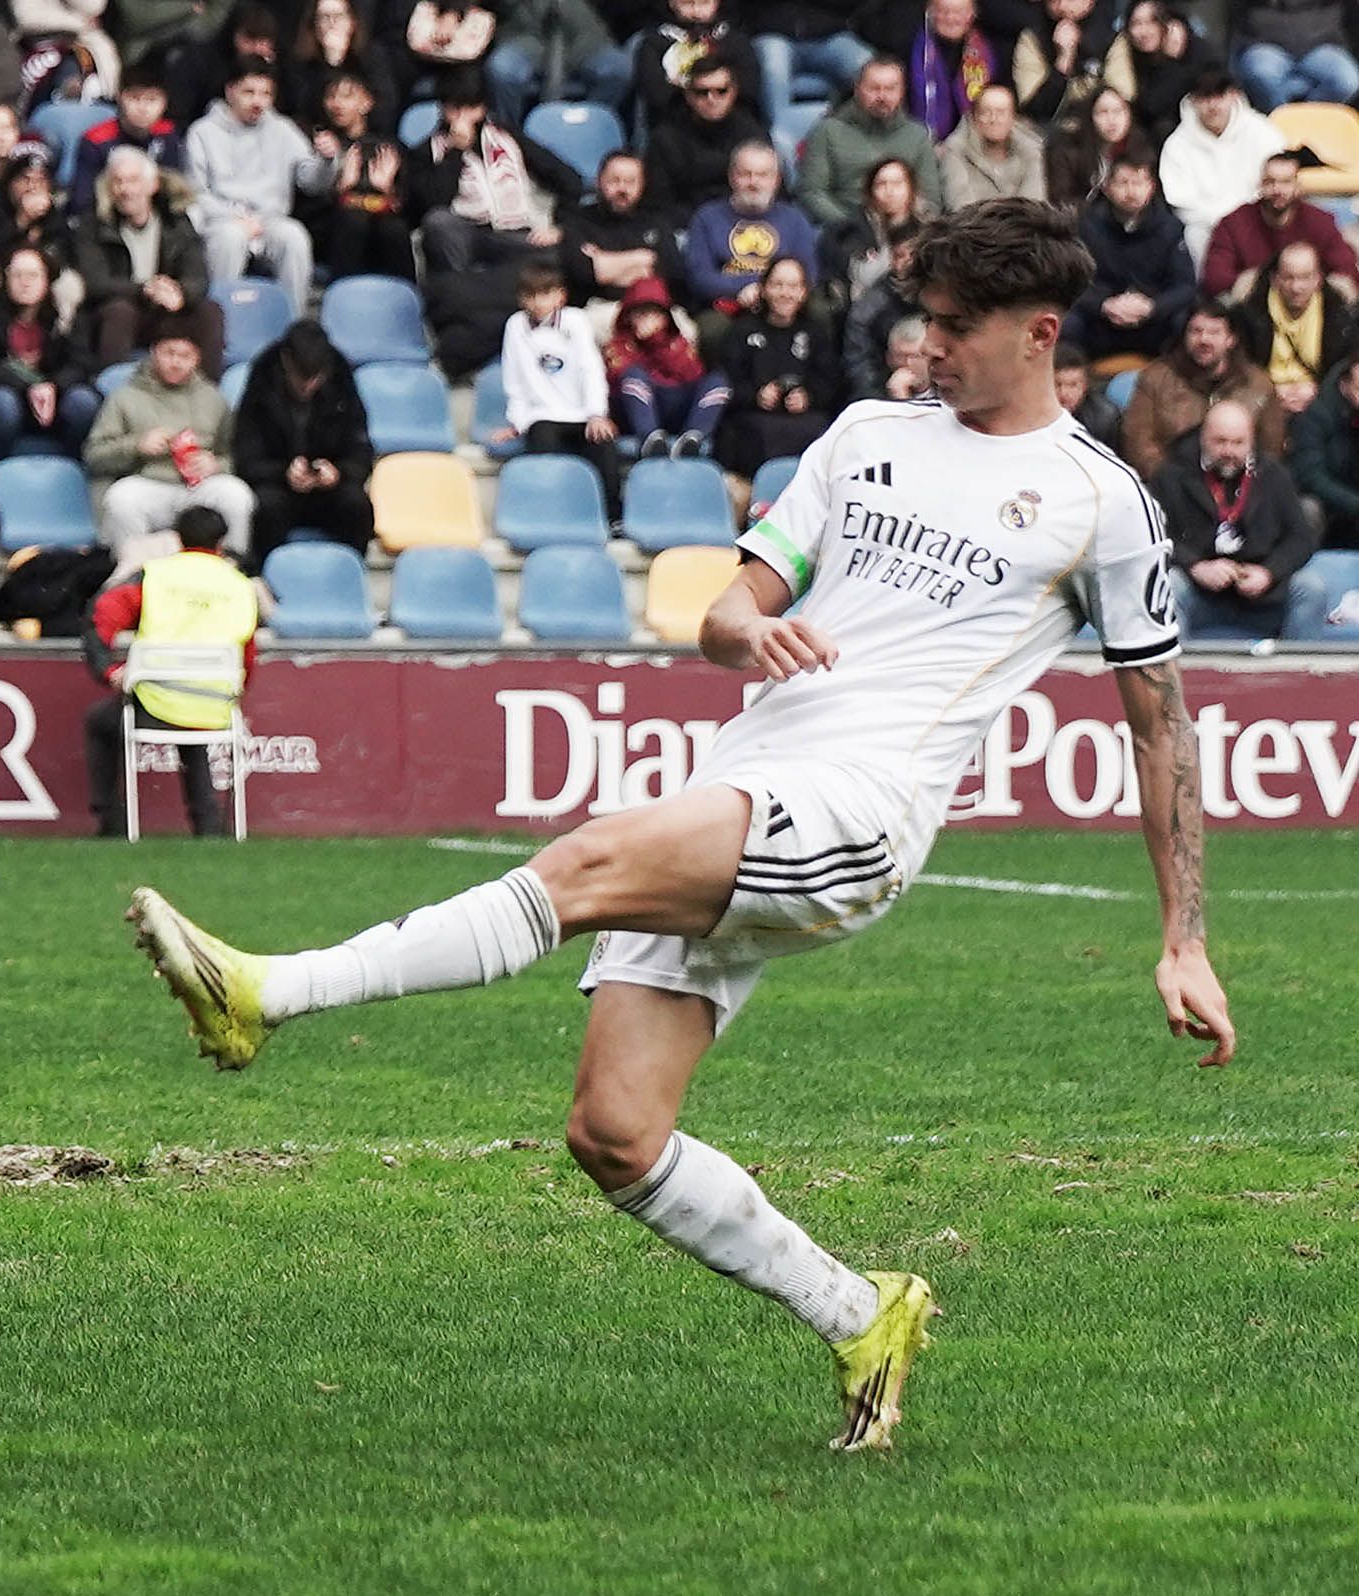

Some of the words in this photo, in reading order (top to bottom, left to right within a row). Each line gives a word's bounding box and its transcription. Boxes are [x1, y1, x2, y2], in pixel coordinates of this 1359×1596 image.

[841, 501, 1011, 586] Emirates
[880, 557, 965, 609] BETTER
[495, 682, 767, 817] Diar
